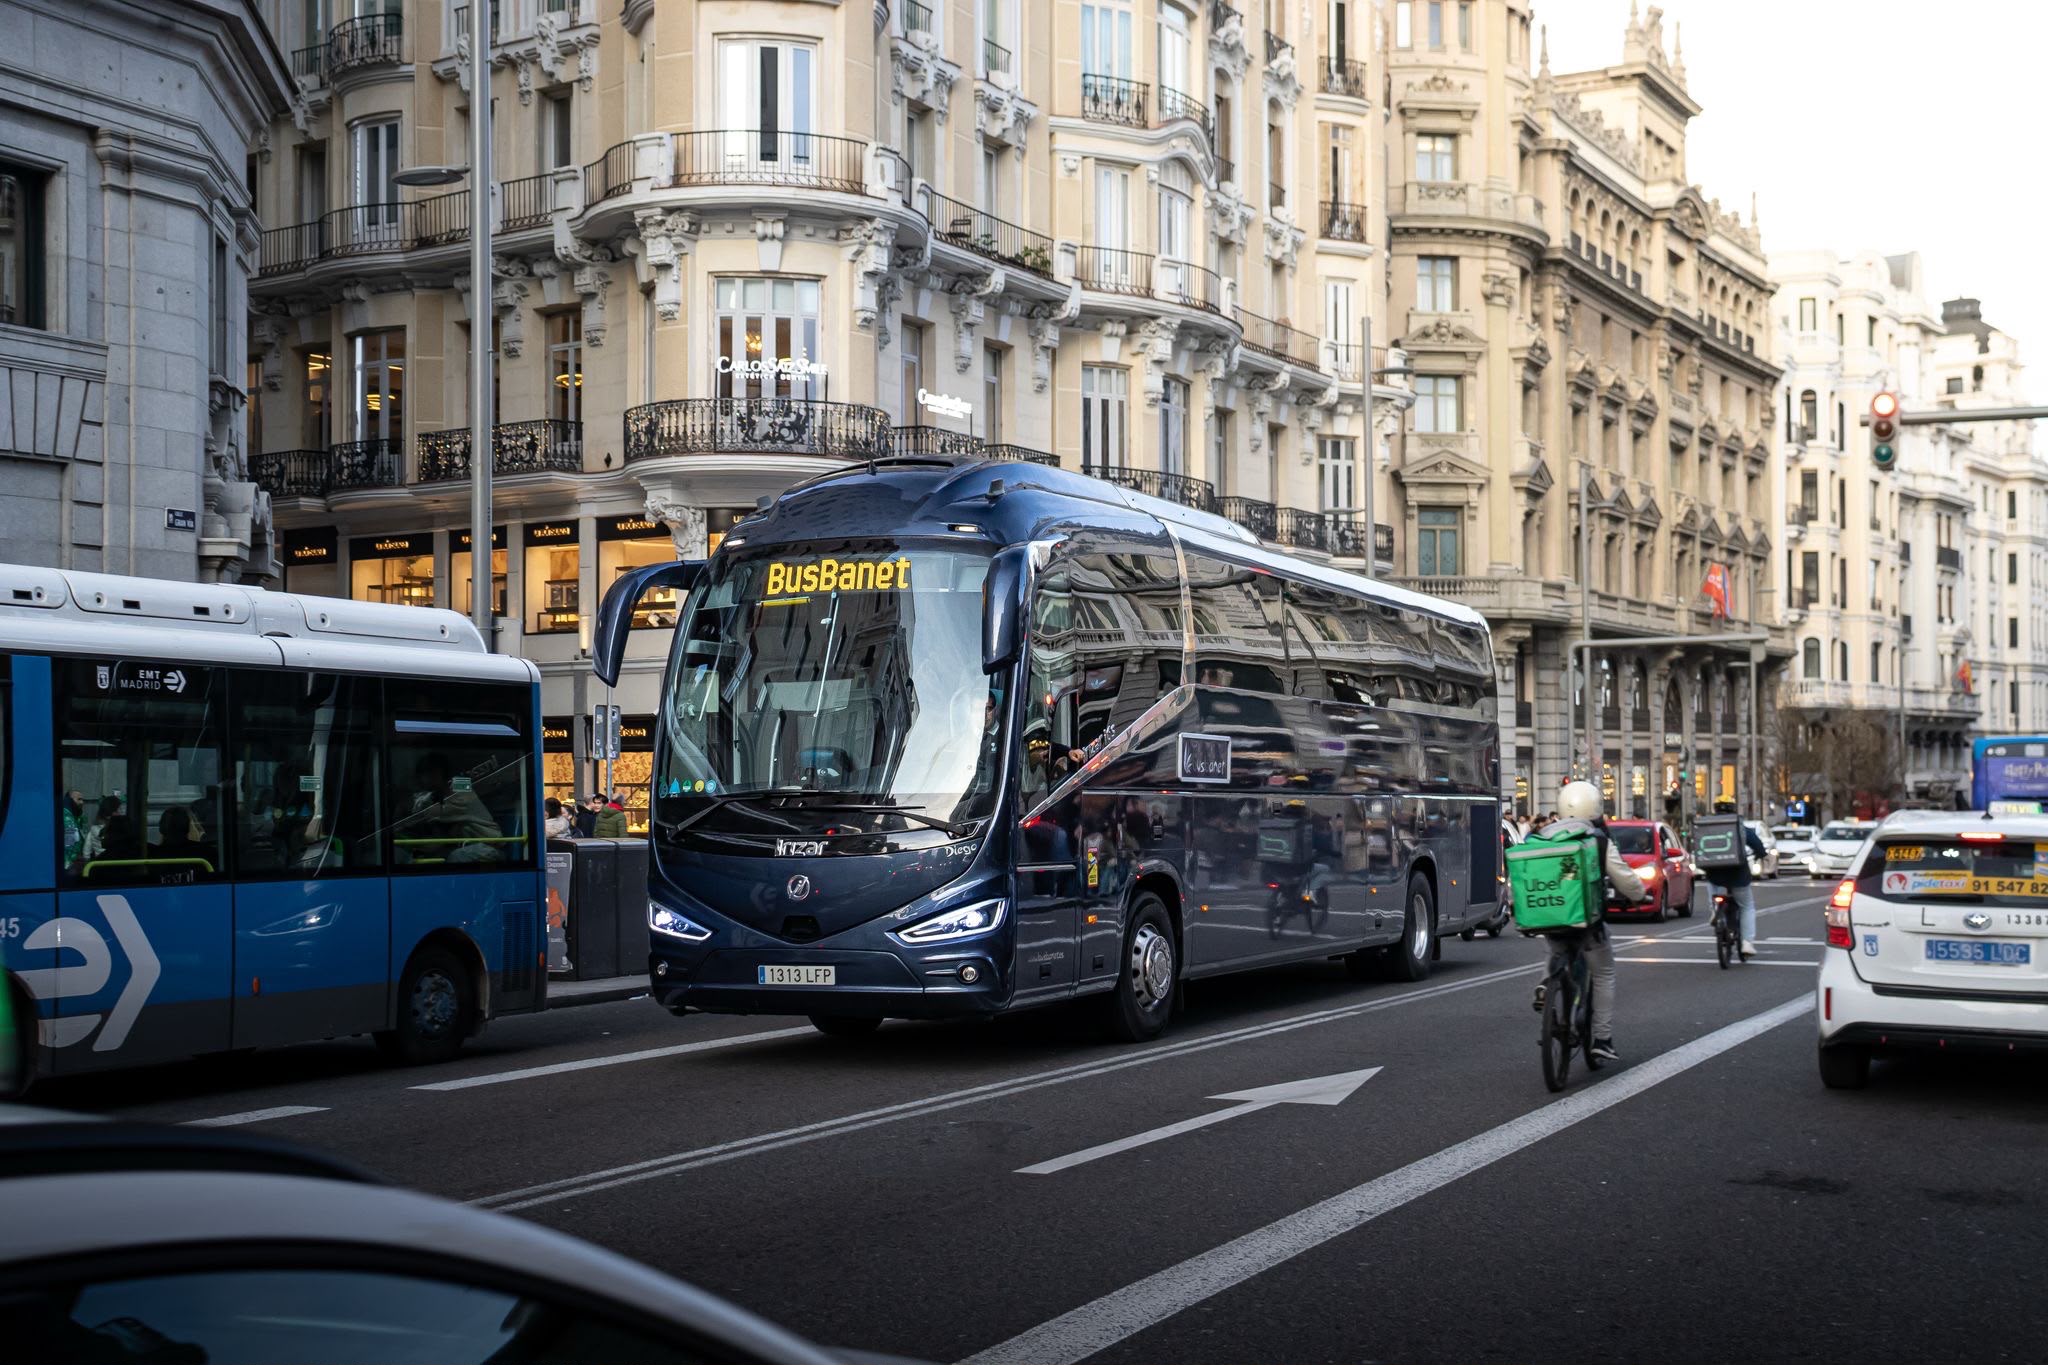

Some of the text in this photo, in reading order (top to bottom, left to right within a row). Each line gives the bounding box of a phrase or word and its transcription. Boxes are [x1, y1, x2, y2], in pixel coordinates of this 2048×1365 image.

[767, 556, 911, 595] BusBanet
[139, 670, 161, 679] EMT
[120, 680, 161, 690] MADRID
[944, 843, 977, 857] Diego
[1912, 878, 1967, 891] pidetaxi
[1972, 880, 1989, 891] 91
[1997, 881, 2025, 892] 547
[1526, 894, 1565, 908] Eats
[1922, 907, 1935, 926] L
[1990, 943, 2027, 962] LDC
[770, 968, 831, 983] 1313 LFP
